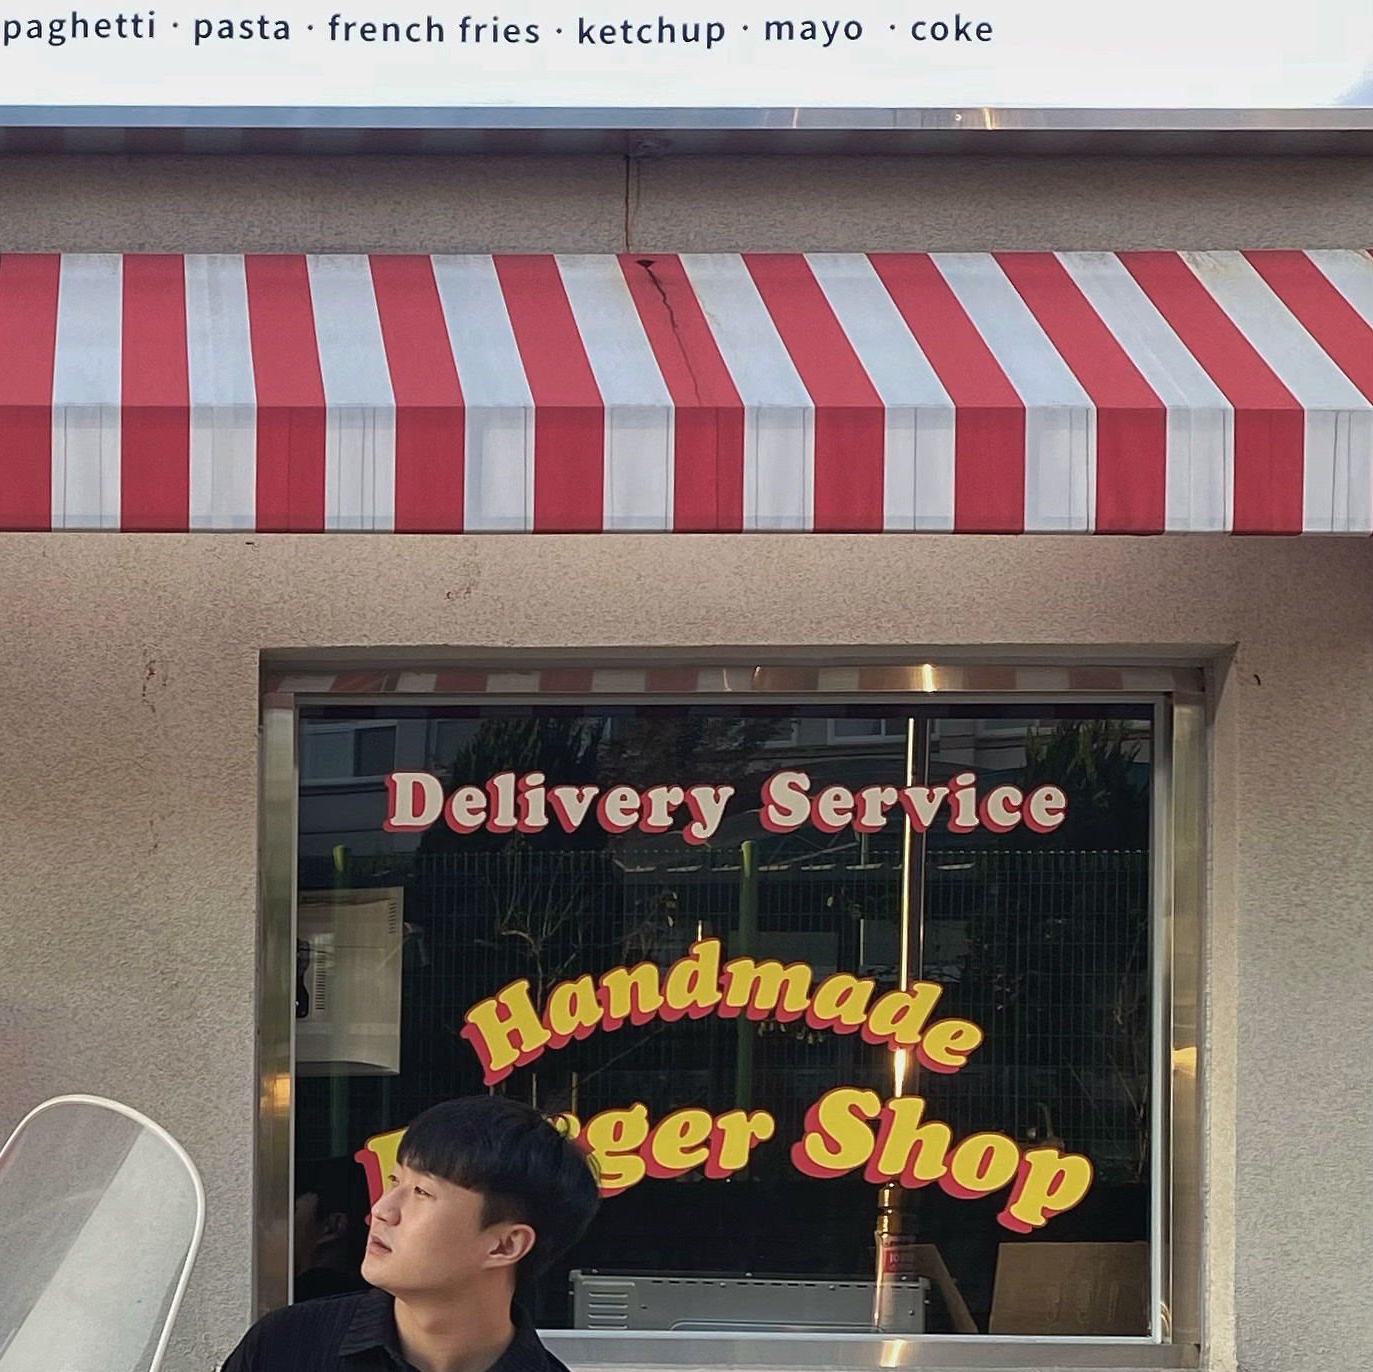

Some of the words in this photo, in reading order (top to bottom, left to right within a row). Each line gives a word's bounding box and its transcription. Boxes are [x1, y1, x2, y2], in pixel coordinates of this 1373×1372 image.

[194, 14, 290, 46] pasta
[328, 13, 445, 42] french
[459, 15, 540, 43] fries
[578, 15, 725, 49] ketchup
[765, 19, 863, 48] mayo
[911, 13, 994, 42] coke
[383, 769, 736, 846] Delivery
[759, 767, 1068, 834] Service
[461, 938, 983, 1084] Handmade
[791, 1086, 1095, 1234] Shop
